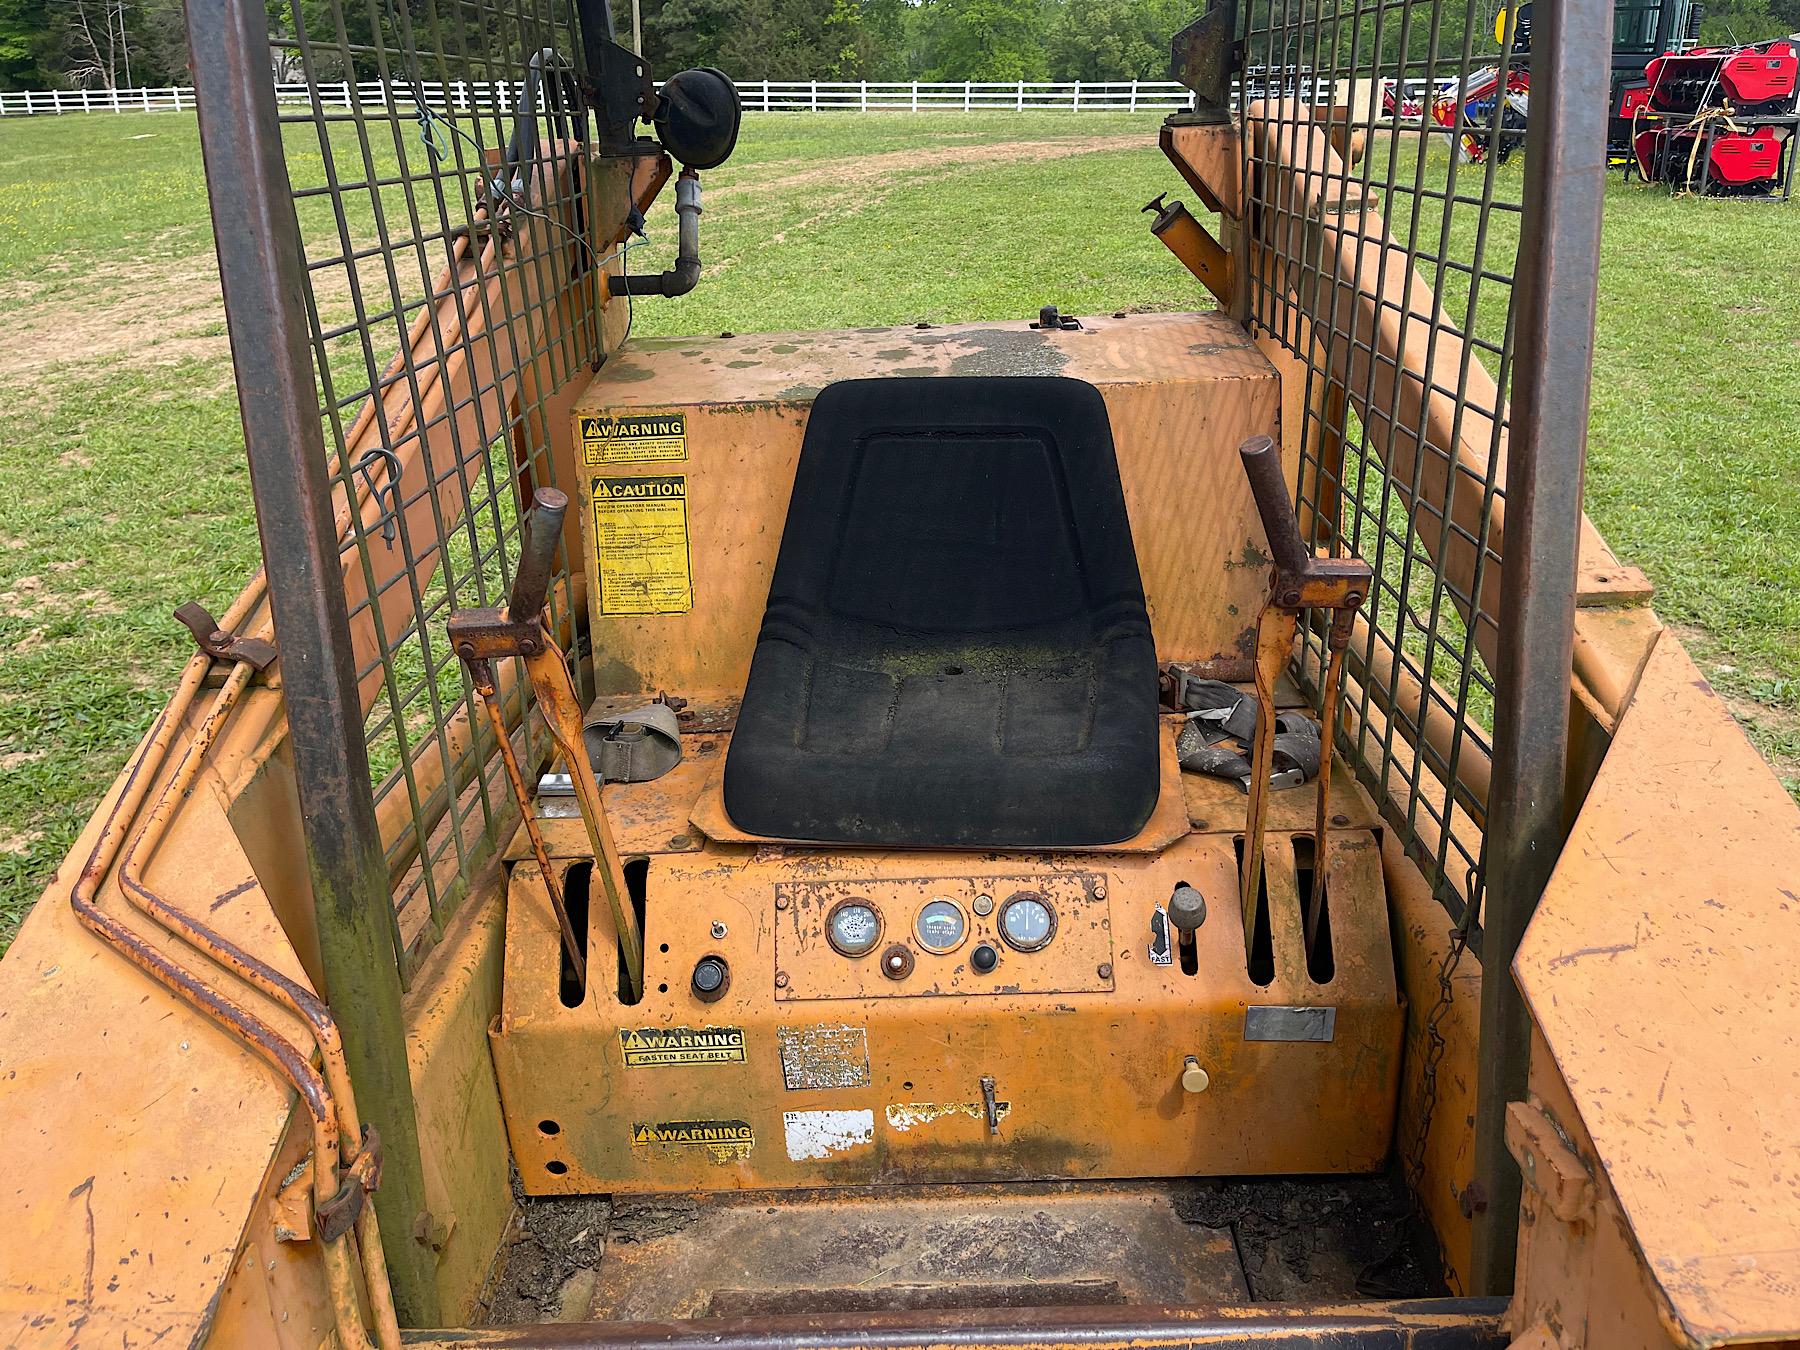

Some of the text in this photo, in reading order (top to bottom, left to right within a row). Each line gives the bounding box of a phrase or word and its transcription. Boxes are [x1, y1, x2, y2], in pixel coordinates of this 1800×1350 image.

[600, 421, 681, 437] WARNING
[612, 483, 685, 497] CAUTION
[645, 1033, 741, 1048] WARNING
[638, 1054, 677, 1062] FASTEN
[657, 1126, 752, 1141] WARNING
